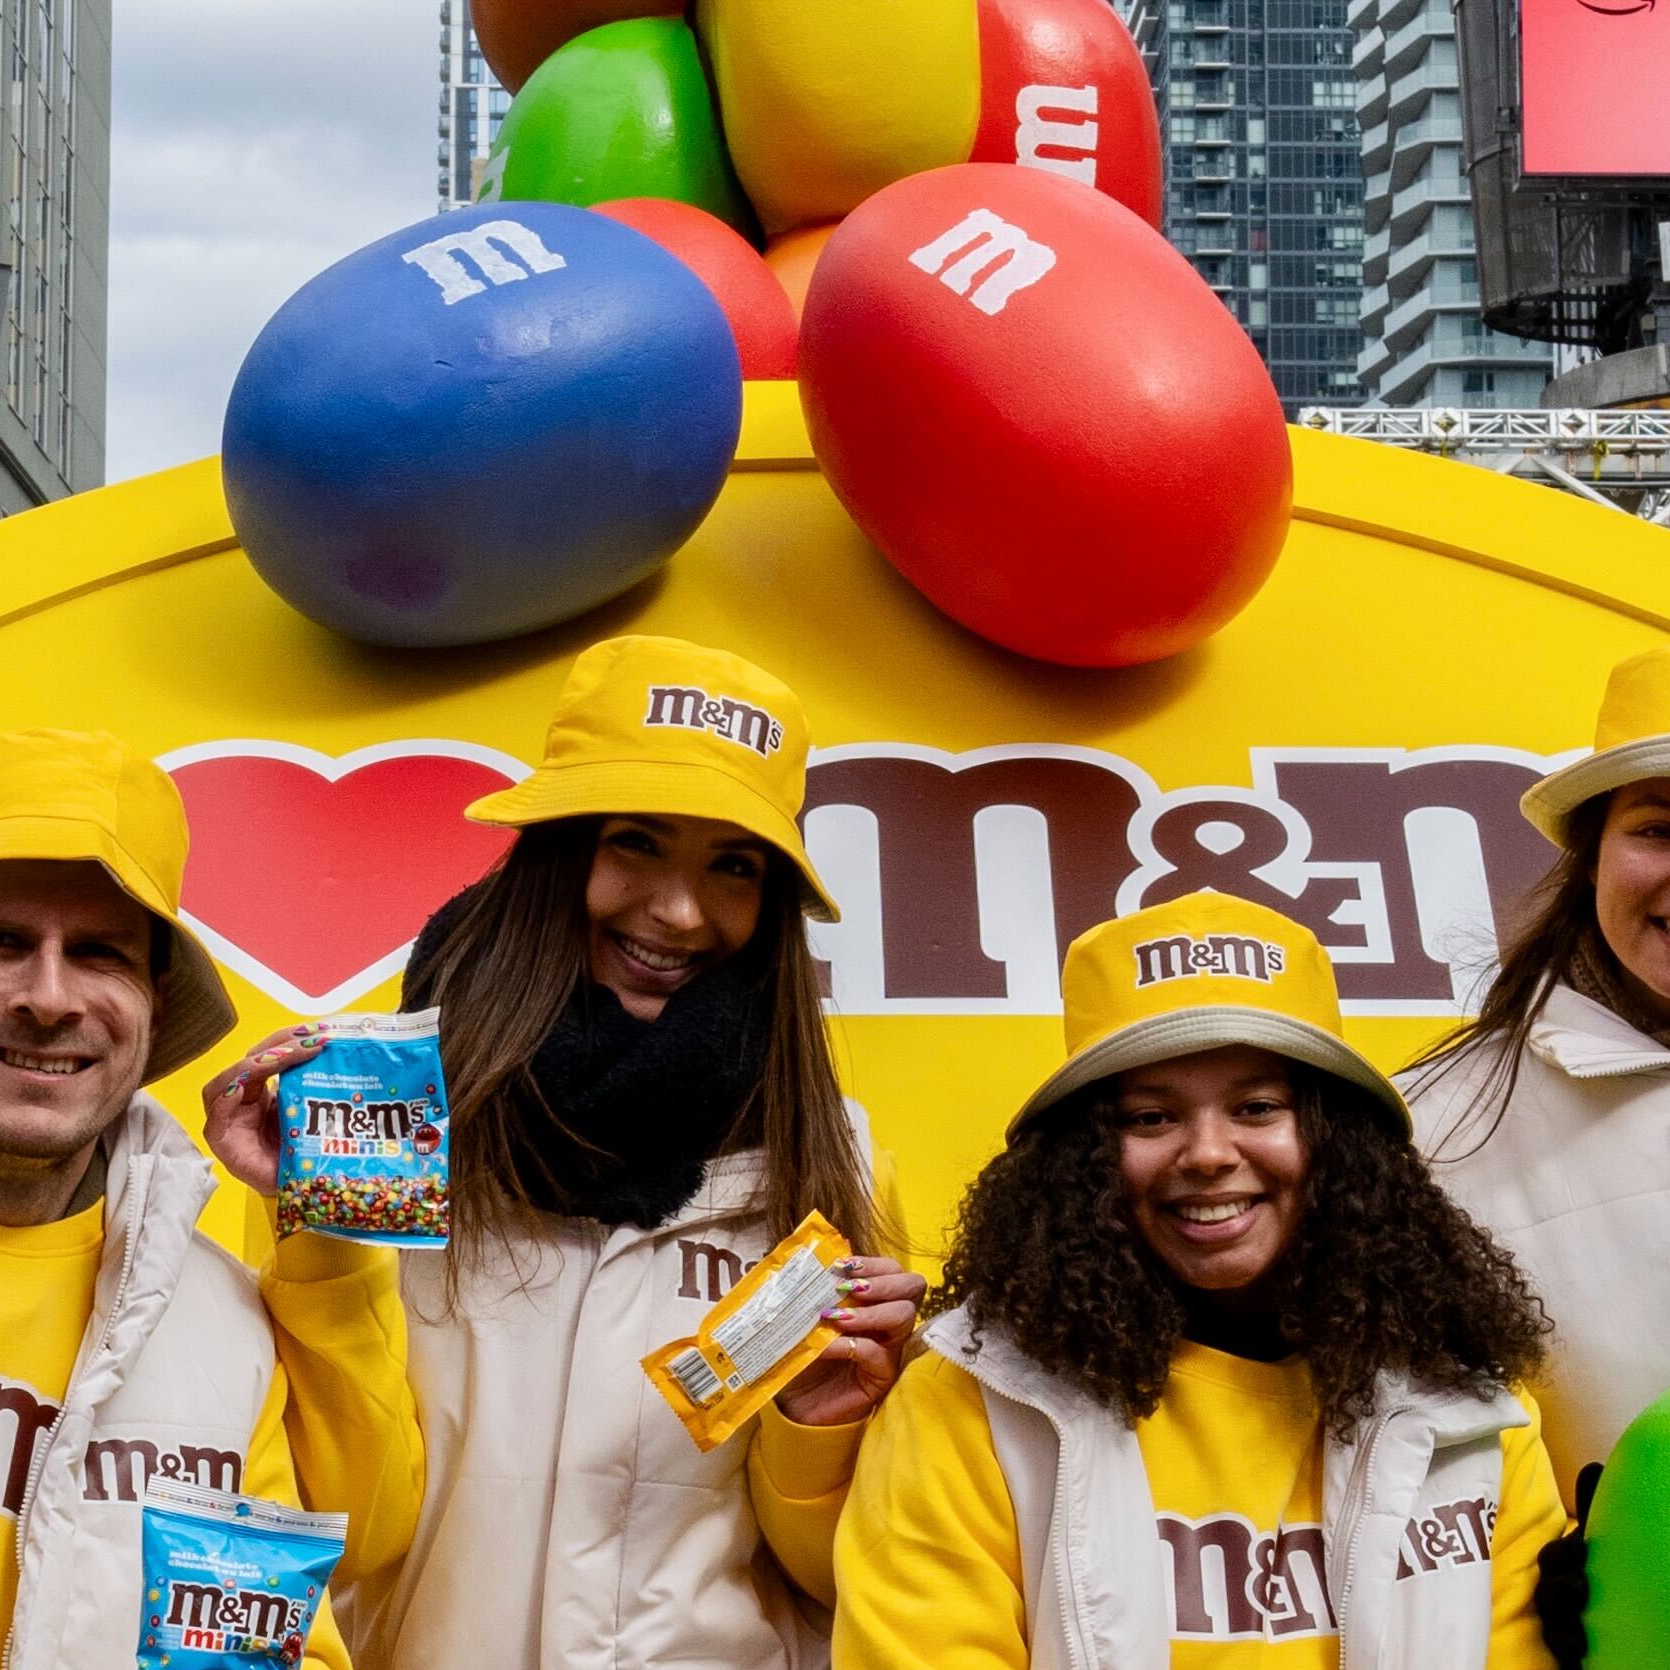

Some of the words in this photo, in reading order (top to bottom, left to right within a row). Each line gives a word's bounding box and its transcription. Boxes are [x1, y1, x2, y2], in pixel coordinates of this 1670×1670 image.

[403, 219, 567, 305] m
[908, 208, 1057, 315] m
[323, 1138, 400, 1155] minis
